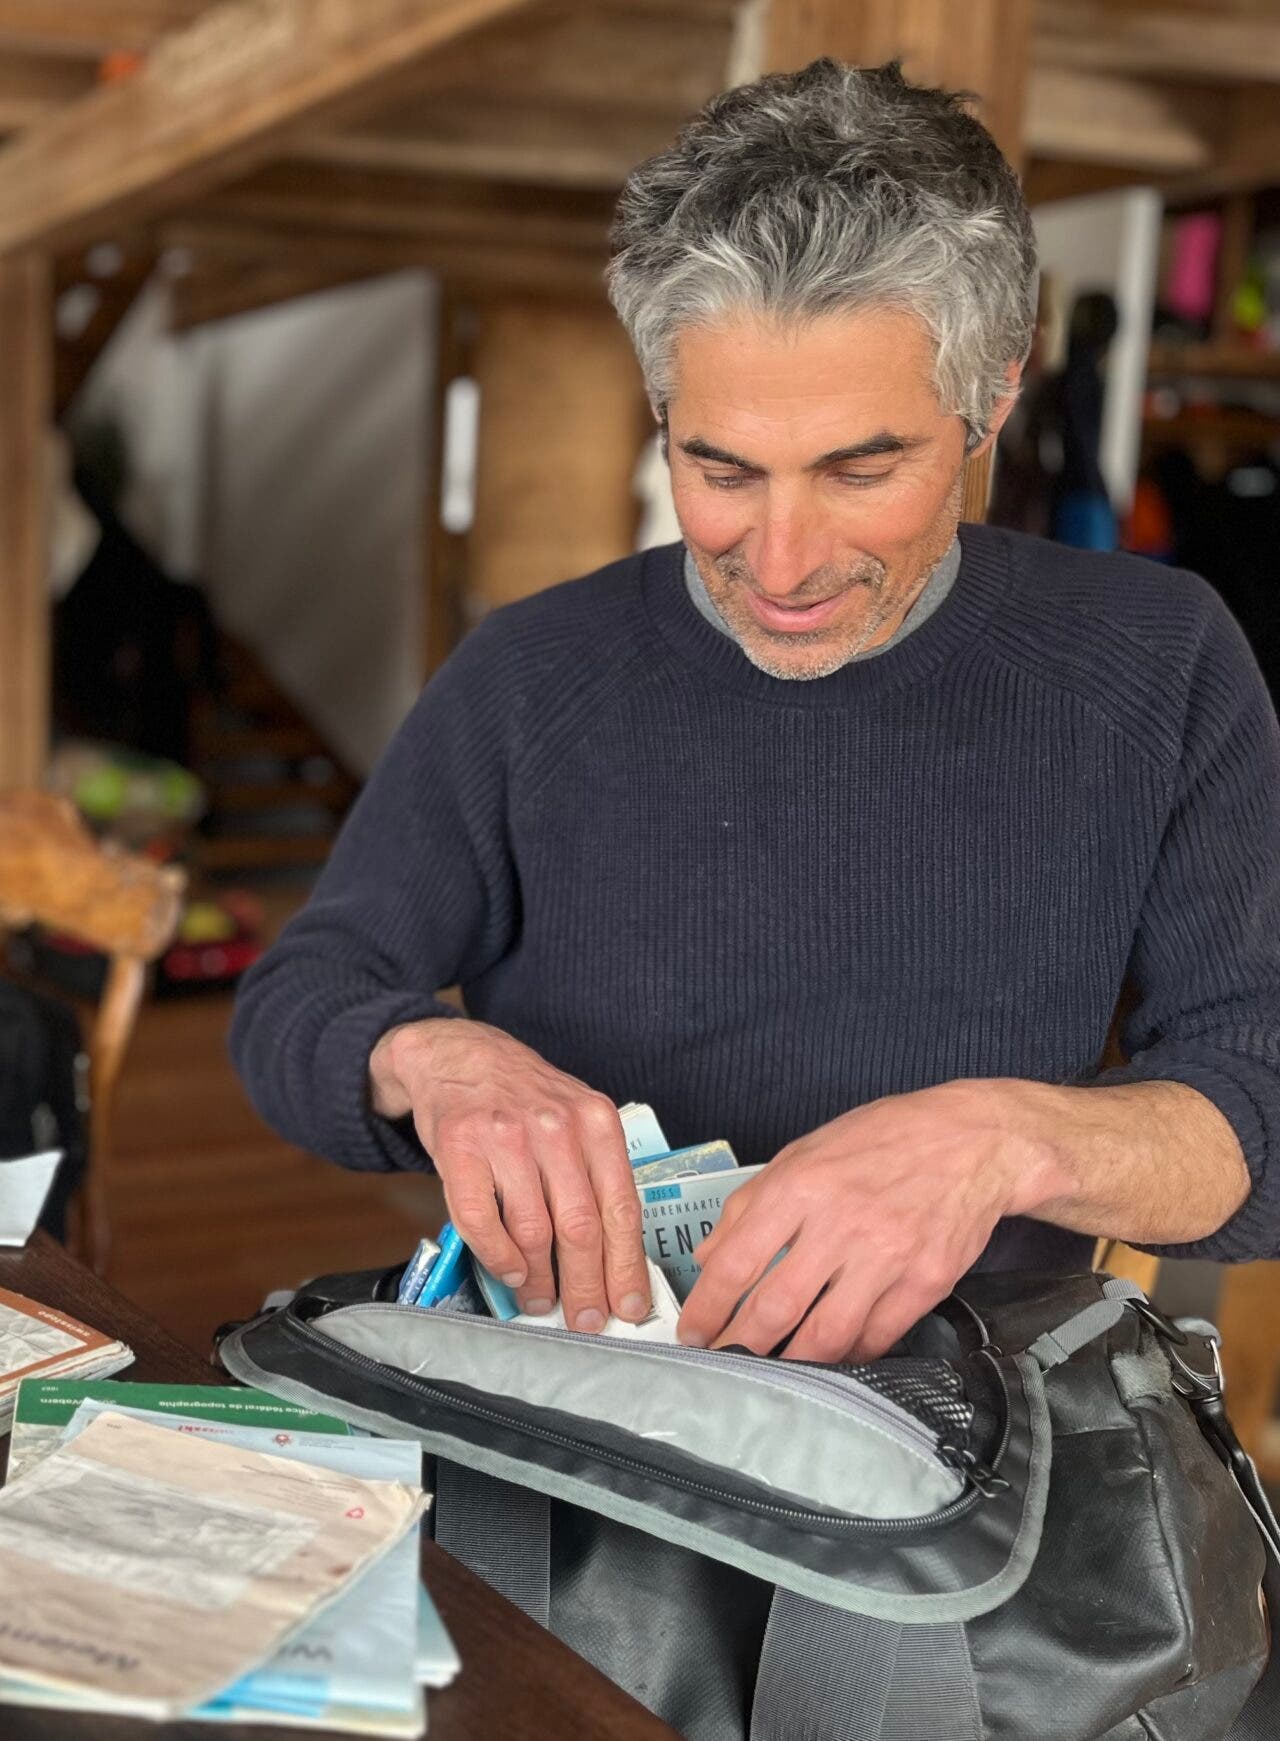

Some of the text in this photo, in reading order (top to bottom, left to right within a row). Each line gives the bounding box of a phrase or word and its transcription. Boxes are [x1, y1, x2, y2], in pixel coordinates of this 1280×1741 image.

[643, 1197, 721, 1219] OURENKARTE
[158, 1399, 226, 1411] topographie
[228, 1402, 243, 1411] de
